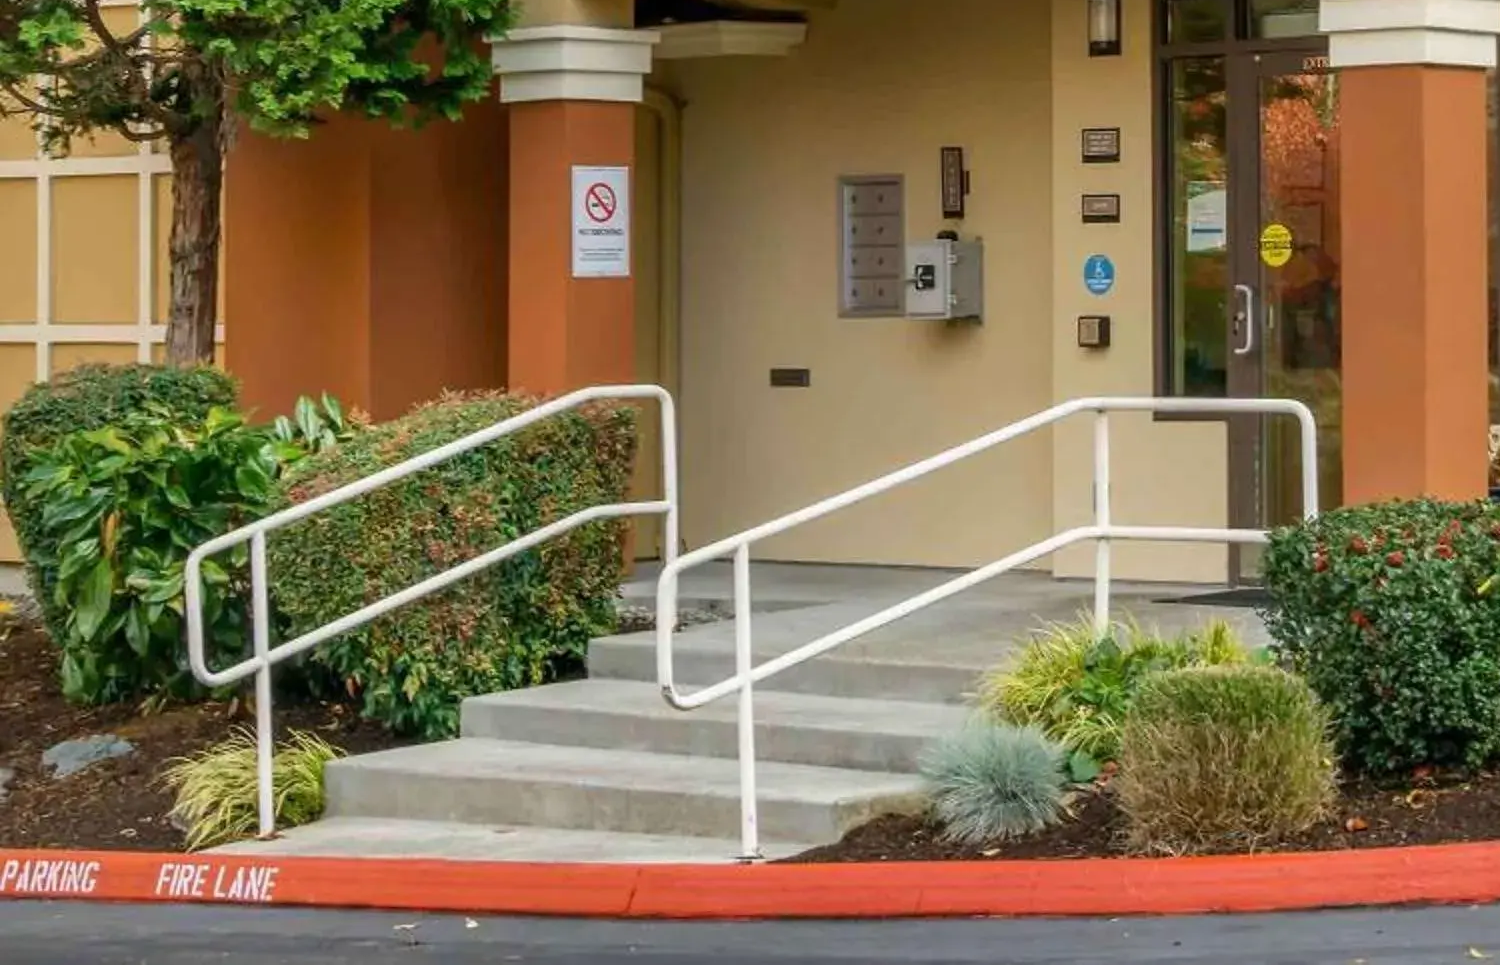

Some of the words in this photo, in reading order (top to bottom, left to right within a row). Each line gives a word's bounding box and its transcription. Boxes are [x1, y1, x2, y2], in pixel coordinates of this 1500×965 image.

[0, 859, 100, 893] PARKING
[155, 862, 209, 896] FIRE
[213, 864, 279, 900] LANE
